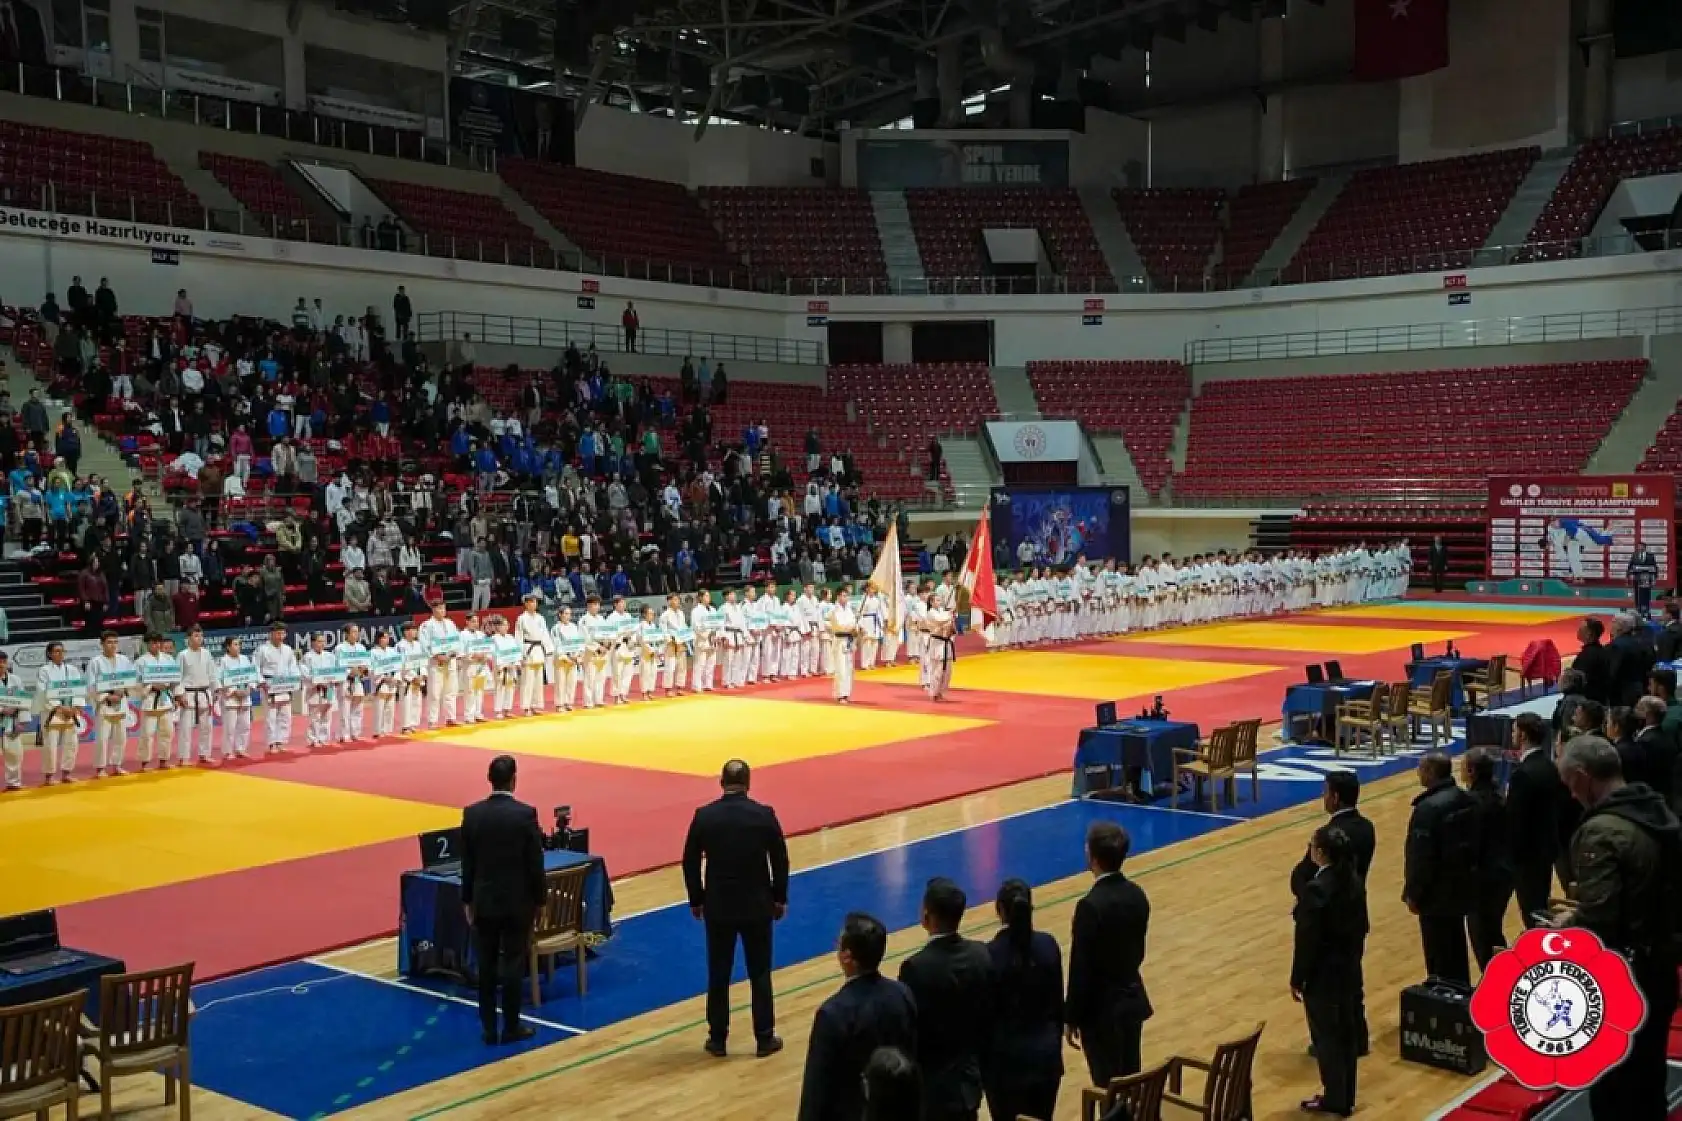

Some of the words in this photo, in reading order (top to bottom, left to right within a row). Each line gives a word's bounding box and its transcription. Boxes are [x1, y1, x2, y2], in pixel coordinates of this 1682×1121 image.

[0, 209, 80, 234] Geleceğe
[86, 220, 195, 247] Hazırlıyoruz.
[437, 837, 450, 858] 2
